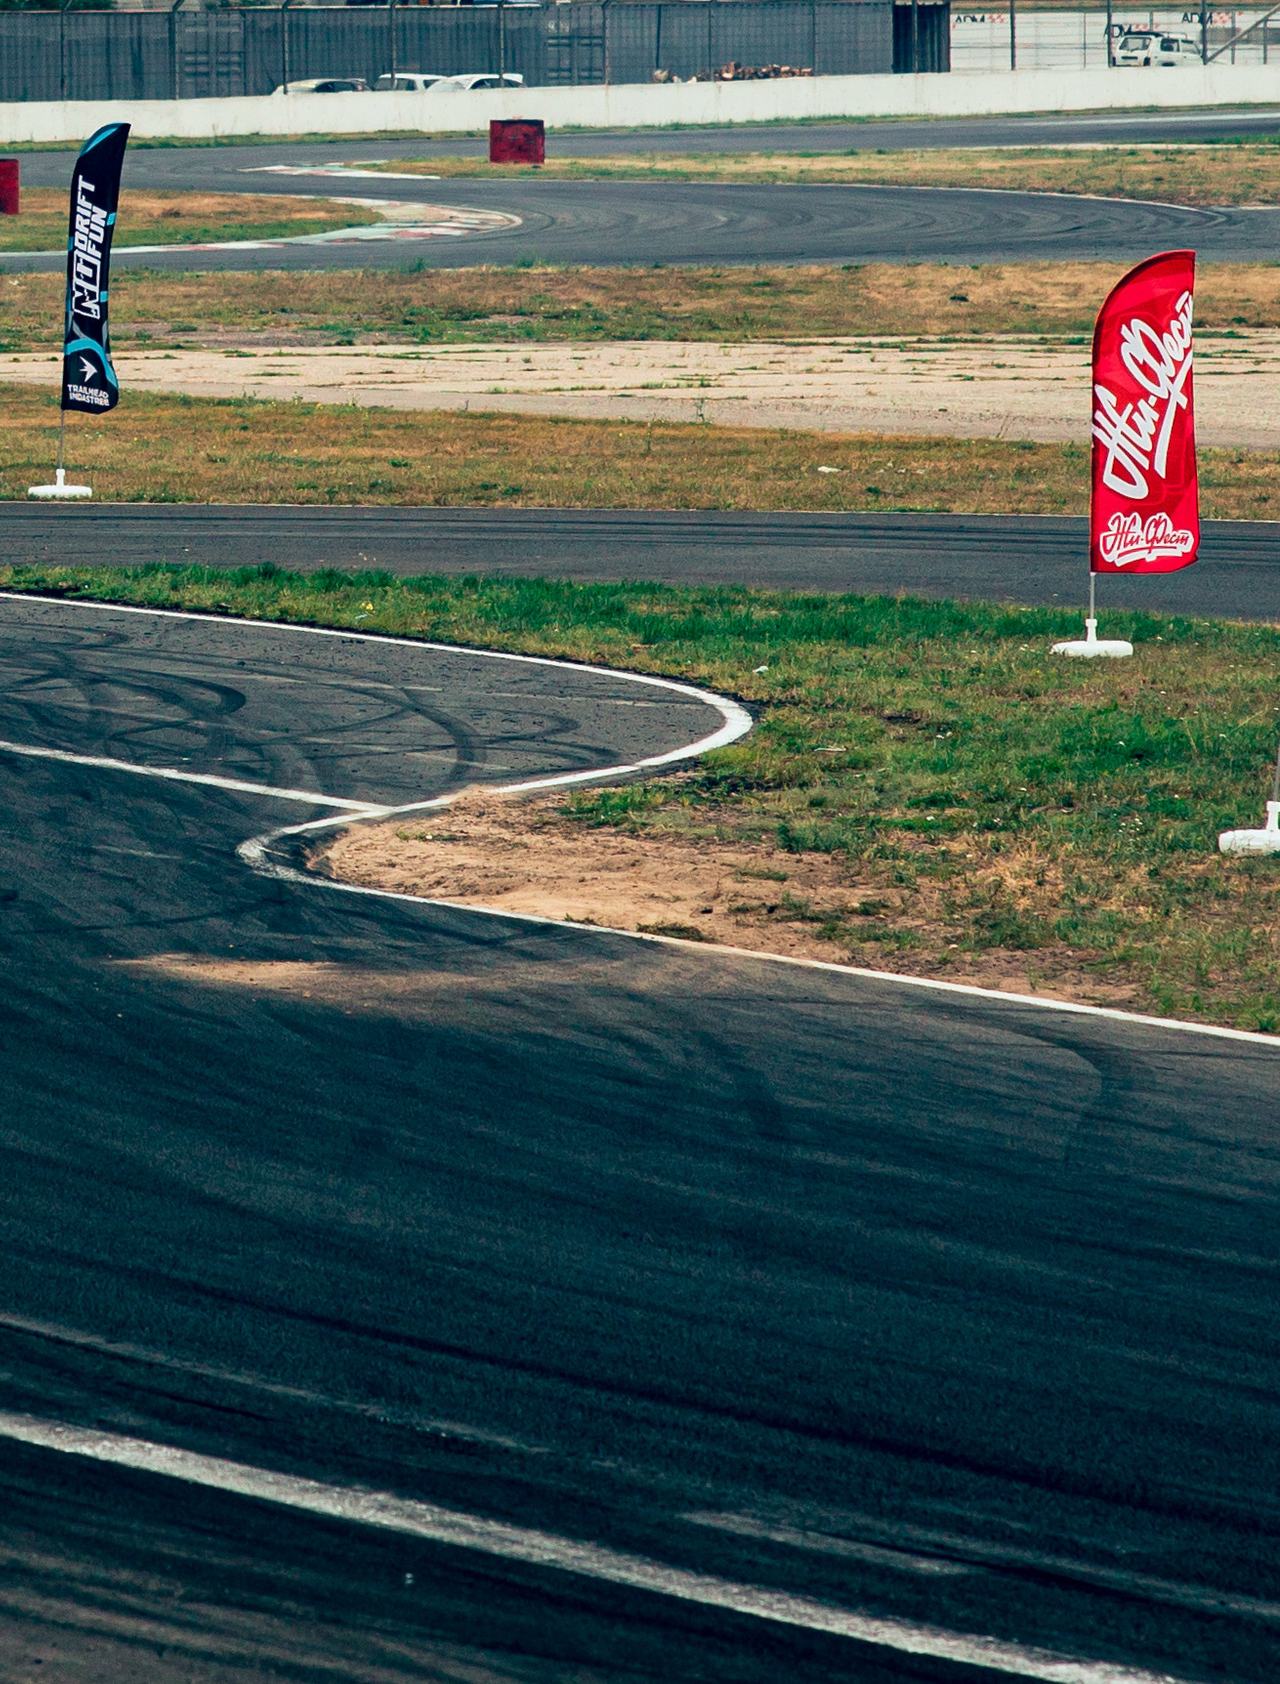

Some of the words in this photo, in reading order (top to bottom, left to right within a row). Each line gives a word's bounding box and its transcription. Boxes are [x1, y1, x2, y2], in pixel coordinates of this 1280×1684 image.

[74, 174, 95, 252] DRIFT
[87, 205, 108, 259] FUN
[1101, 513, 1192, 560] Жи-Фест
